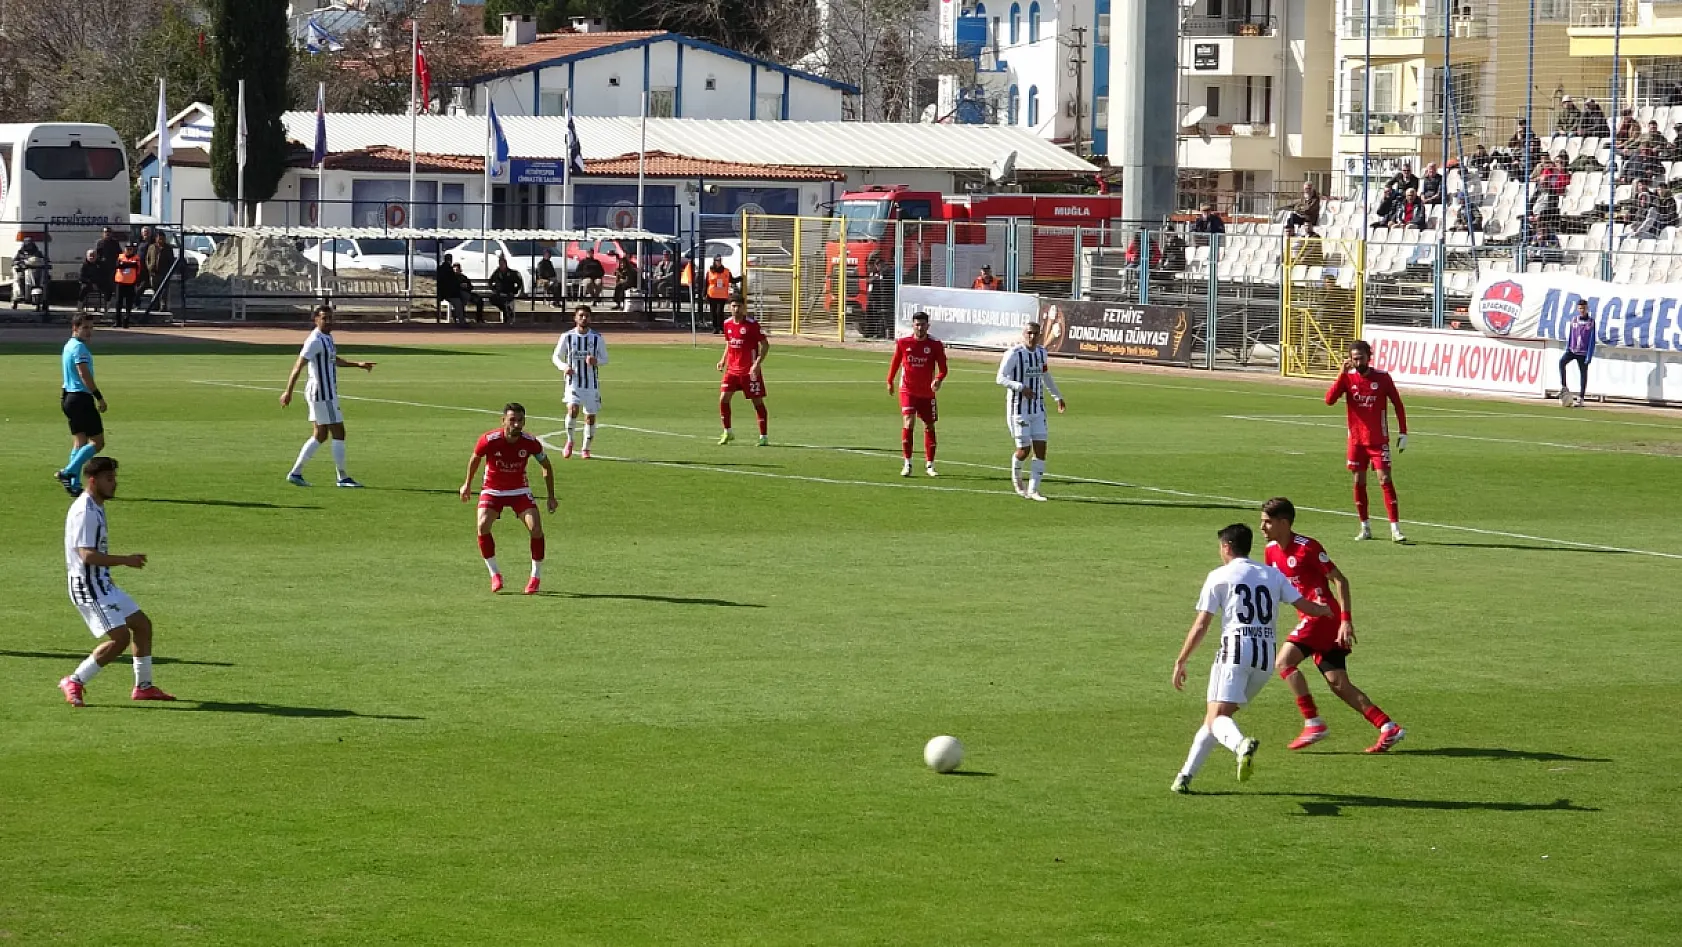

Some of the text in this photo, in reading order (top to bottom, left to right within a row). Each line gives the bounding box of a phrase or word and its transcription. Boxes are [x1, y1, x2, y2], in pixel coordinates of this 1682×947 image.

[1055, 205, 1090, 216] MUĞLA
[1103, 306, 1145, 323] FETHİYE
[1068, 325, 1170, 345] DONDURMA DÜNYASI
[1368, 338, 1454, 377] ABDULLAH
[1456, 344, 1542, 384] KOYUNCU
[1235, 583, 1273, 625] 30
